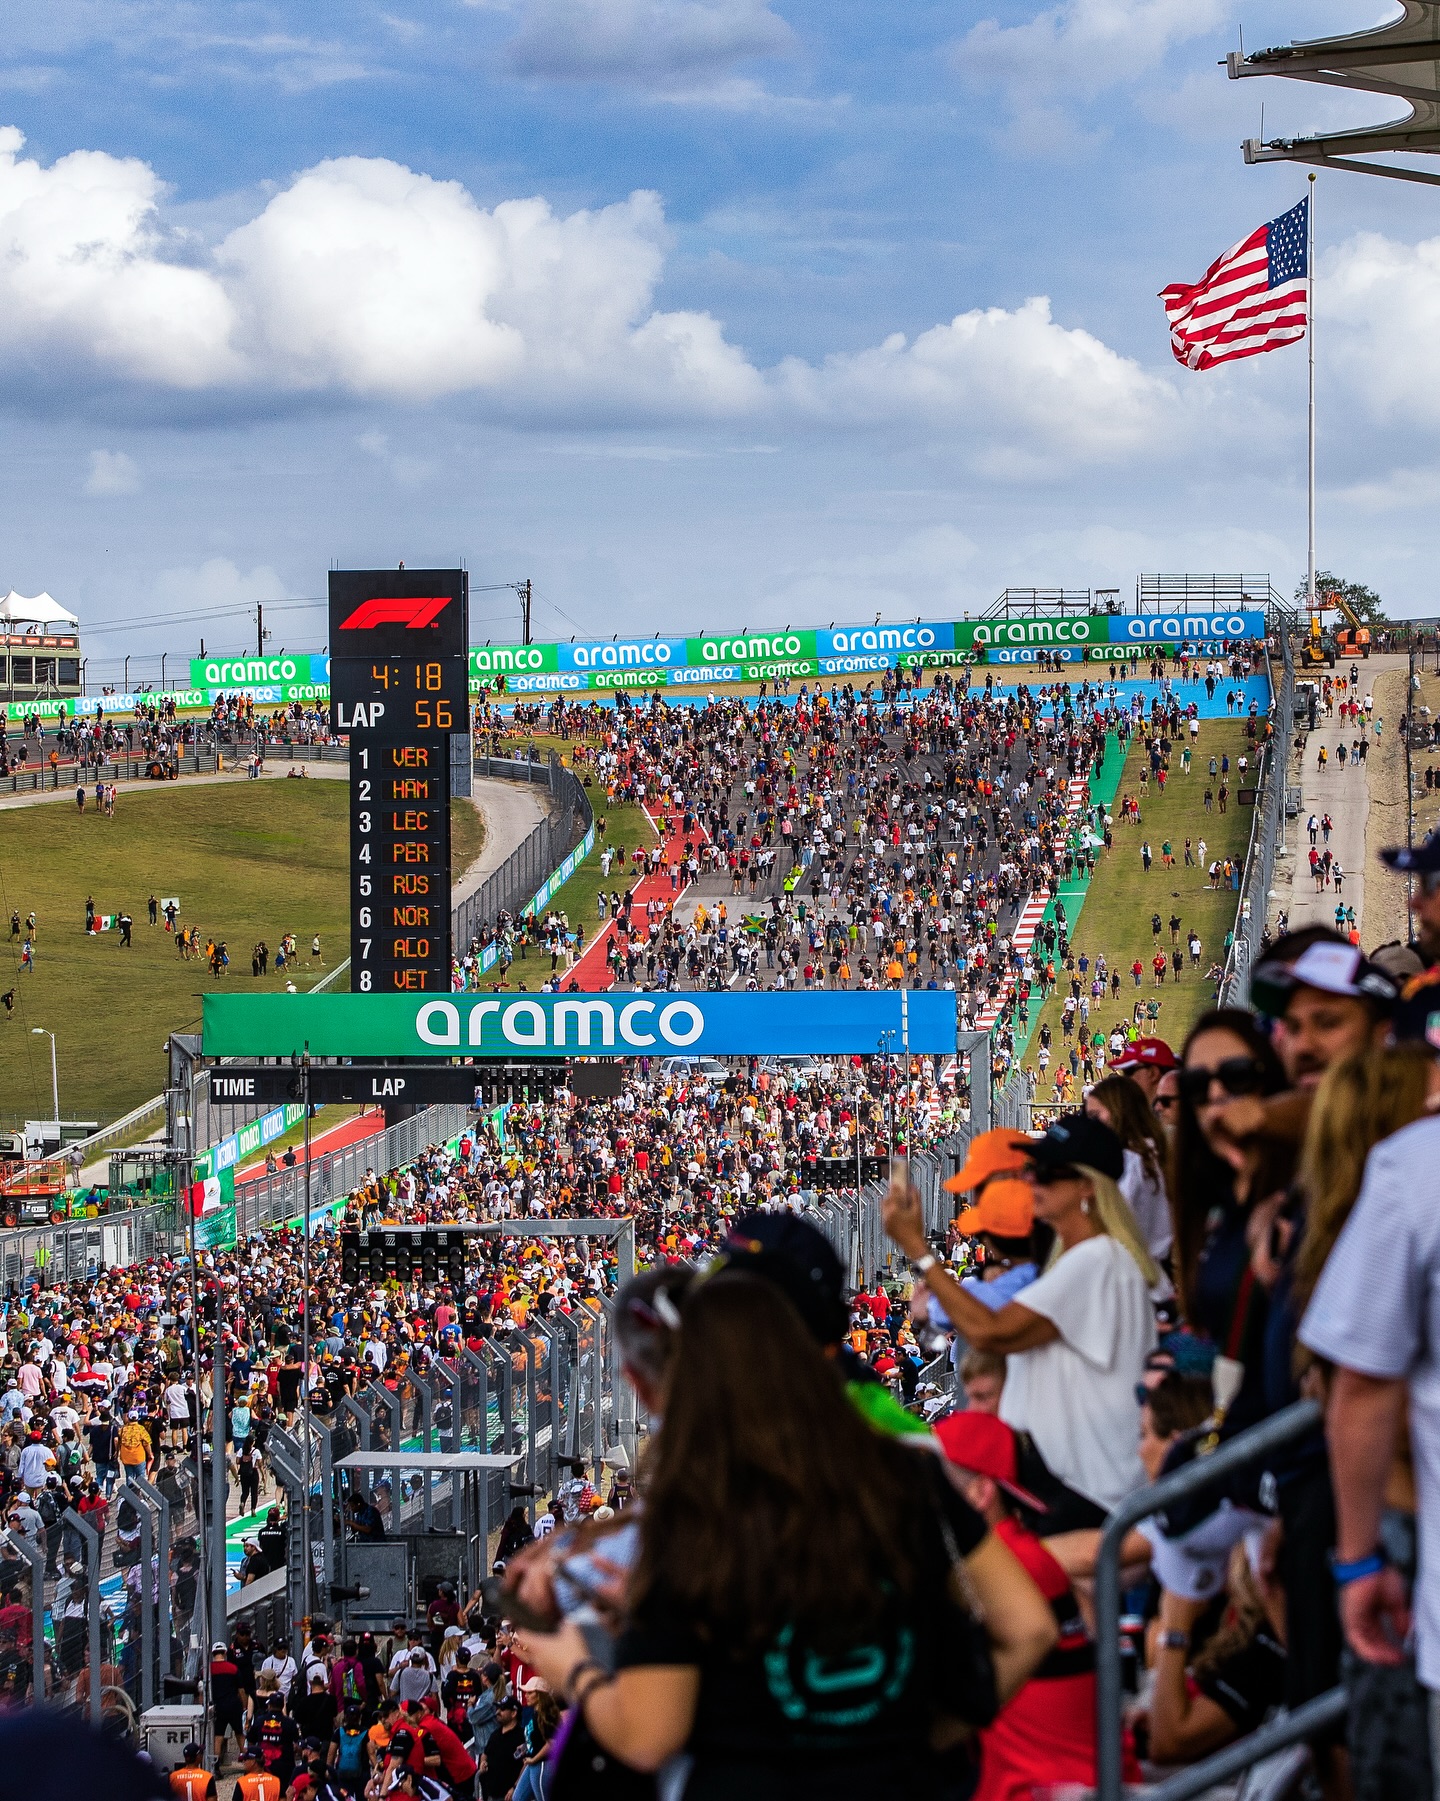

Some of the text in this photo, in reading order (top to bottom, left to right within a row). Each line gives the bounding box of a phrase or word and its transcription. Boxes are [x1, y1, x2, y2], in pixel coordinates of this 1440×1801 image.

[973, 621, 1089, 643] aramco
[1128, 616, 1245, 638] aramco
[702, 636, 801, 661] aramco
[832, 628, 935, 651] aramco
[469, 649, 543, 670] ramco
[573, 643, 671, 666] aramco
[826, 656, 889, 672] aramco
[205, 660, 296, 683] aramco
[372, 663, 441, 690] 4:18
[596, 672, 657, 686] aramco
[674, 667, 733, 682] aramco
[749, 662, 810, 678] aramco
[288, 685, 330, 699] aram
[517, 675, 579, 690] aramco
[337, 700, 452, 728] LAP 56
[359, 748, 428, 769] 1 VER
[359, 780, 428, 801] 2 HAM
[359, 811, 428, 832] 3 LEC
[359, 843, 429, 864] 4 PER
[360, 875, 429, 896] 5 RUS
[360, 907, 429, 928] 6 NOR
[360, 938, 429, 959] 7 ALO
[360, 970, 428, 991] 8 VET
[416, 1000, 704, 1046] aramco
[213, 1078, 405, 1096] TIME LAP
[167, 1731, 190, 1743] RF
